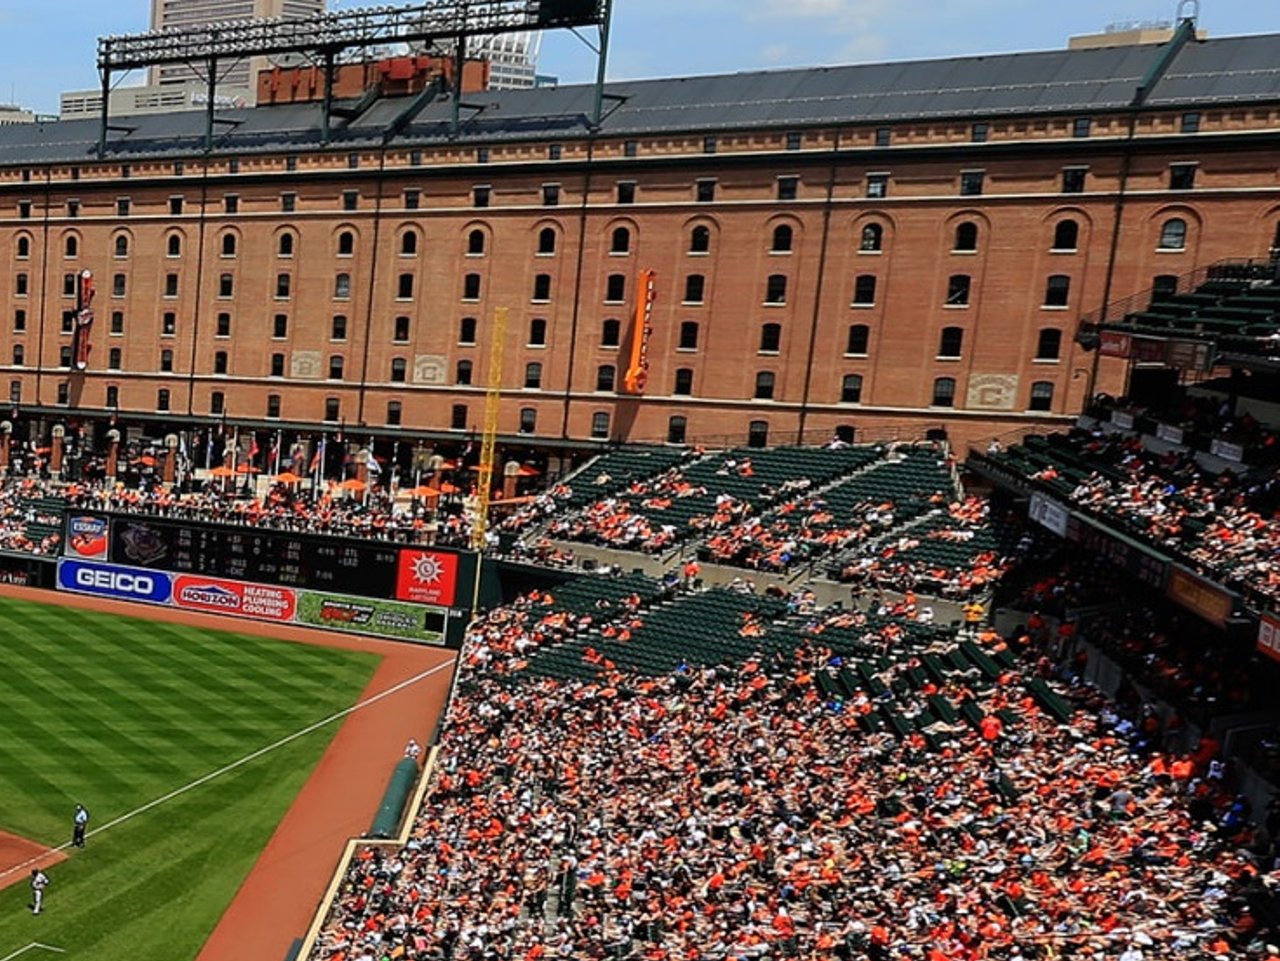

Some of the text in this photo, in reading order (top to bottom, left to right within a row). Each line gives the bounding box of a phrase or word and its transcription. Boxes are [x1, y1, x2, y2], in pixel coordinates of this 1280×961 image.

[76, 567, 154, 595] GEICO
[182, 590, 239, 607] HORIZON
[243, 585, 283, 599] HEATING
[242, 595, 289, 610] PLUMBING
[242, 603, 283, 617] COOLING
